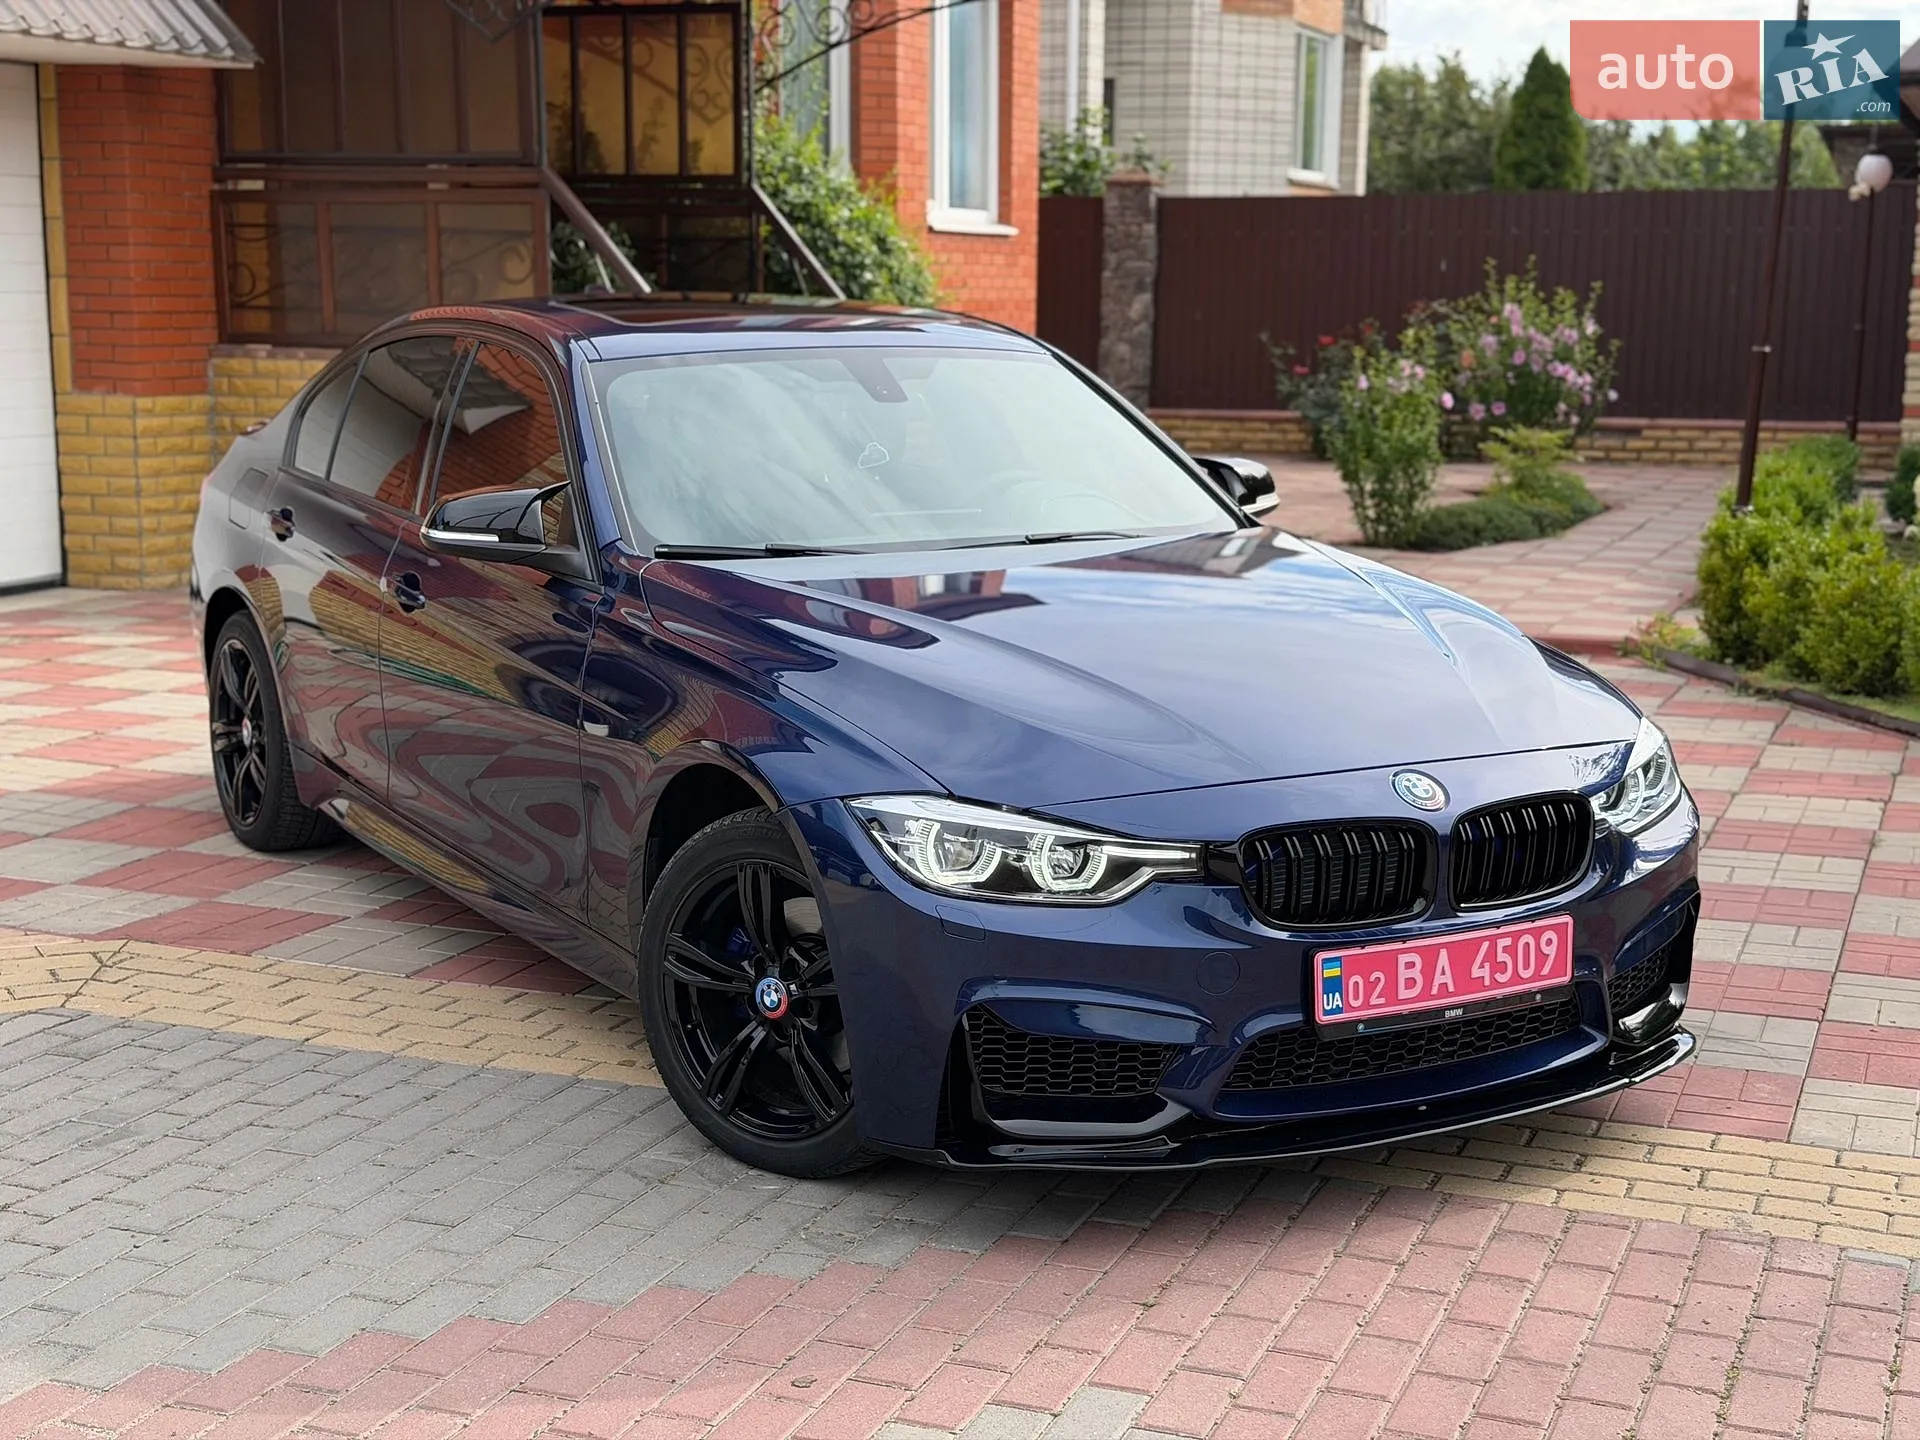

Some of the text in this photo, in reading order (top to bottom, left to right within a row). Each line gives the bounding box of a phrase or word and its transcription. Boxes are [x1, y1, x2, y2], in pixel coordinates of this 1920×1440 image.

[1323, 930, 1559, 1010] UA 02 BA 4509
[1445, 1008, 1463, 1018] BMW
